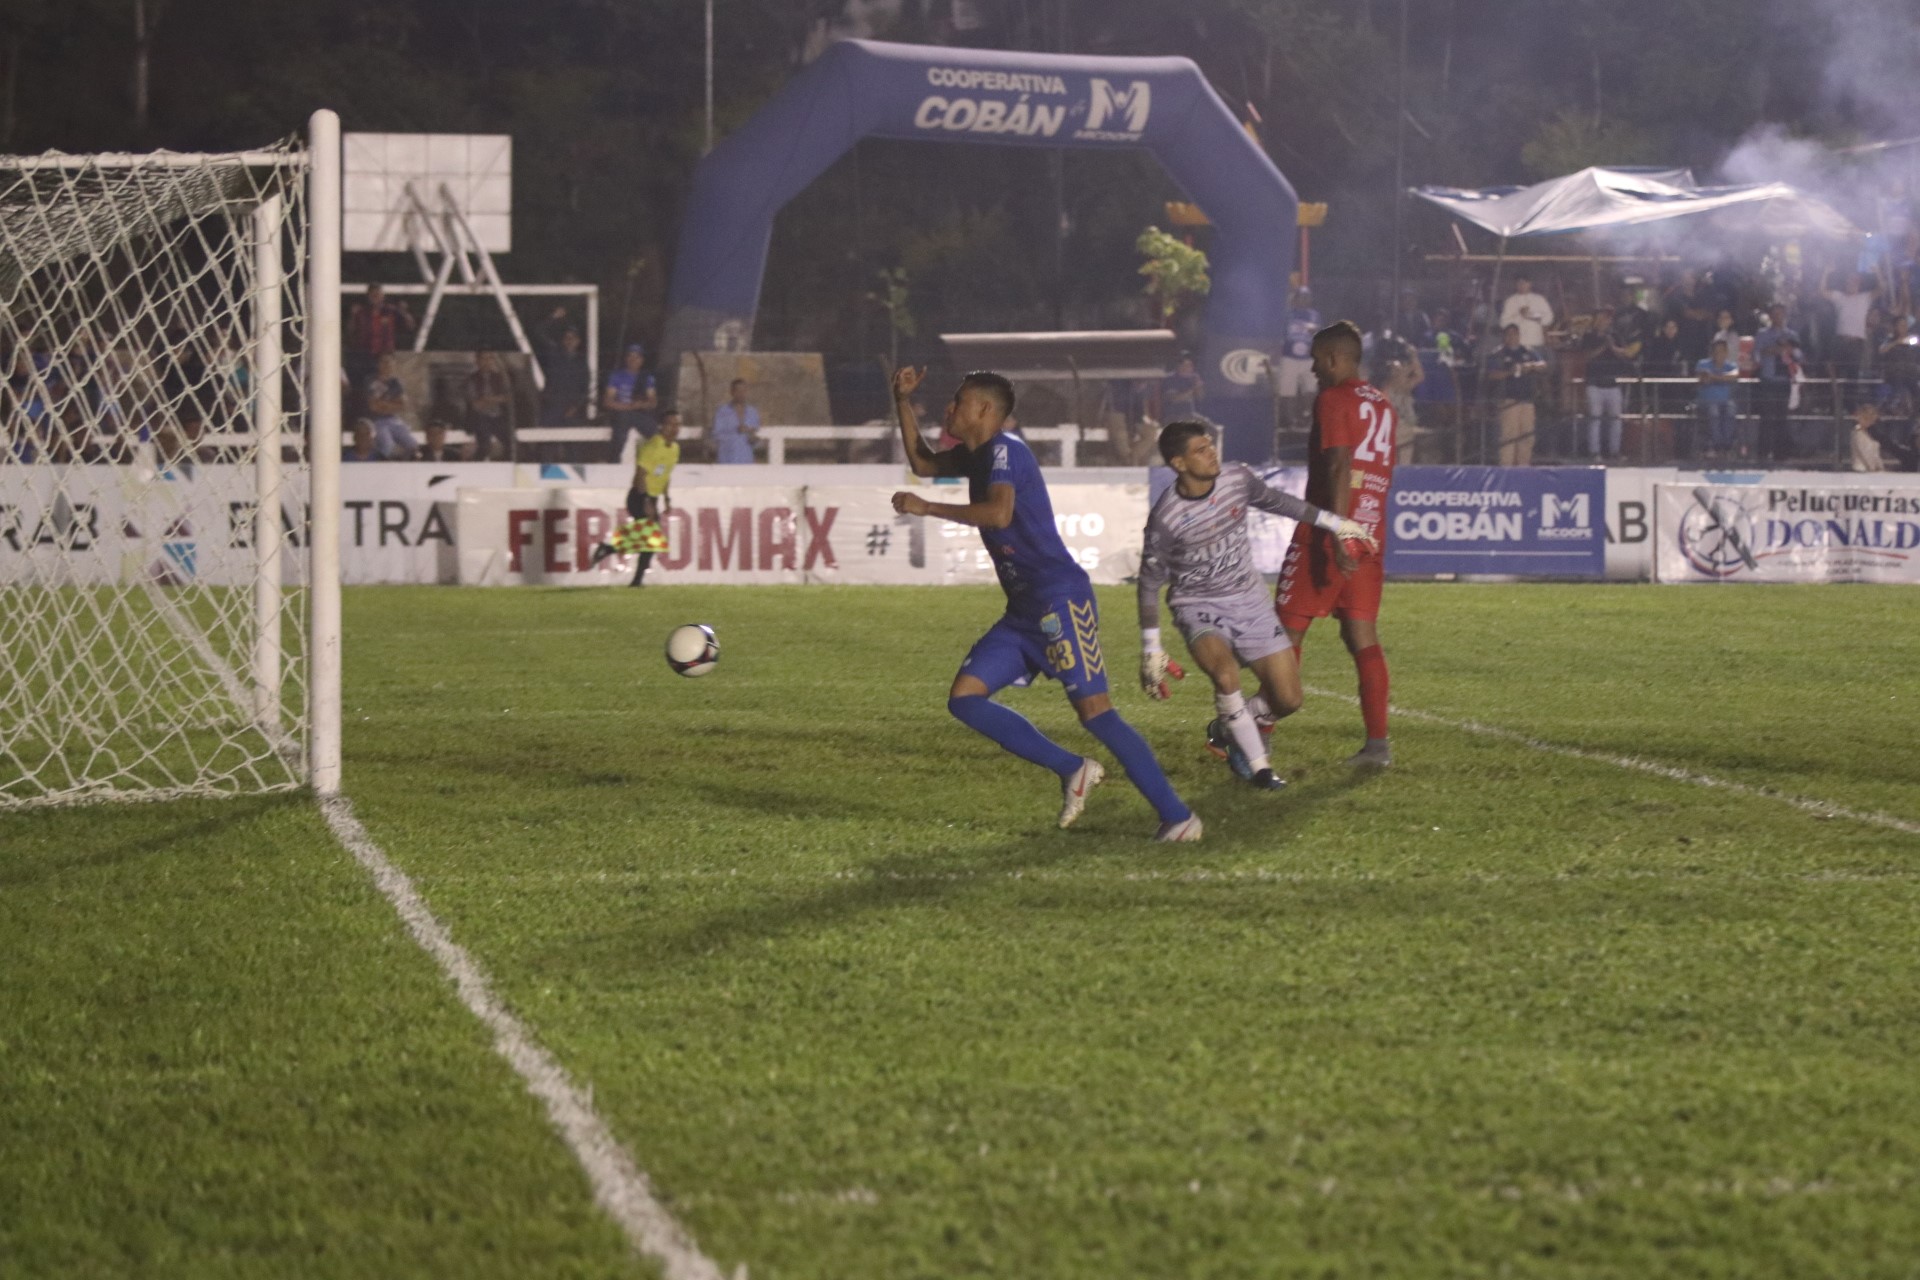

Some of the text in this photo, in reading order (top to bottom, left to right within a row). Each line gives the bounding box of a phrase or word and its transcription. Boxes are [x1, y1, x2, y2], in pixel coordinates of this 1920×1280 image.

[928, 67, 1067, 95] COOPERATIVA
[914, 94, 1067, 137] COBÁN
[1353, 402, 1393, 466] 24
[1395, 491, 1523, 507] COOPERATIVA
[1767, 488, 1920, 519] Peluquerías
[1393, 506, 1523, 542] COBÁN
